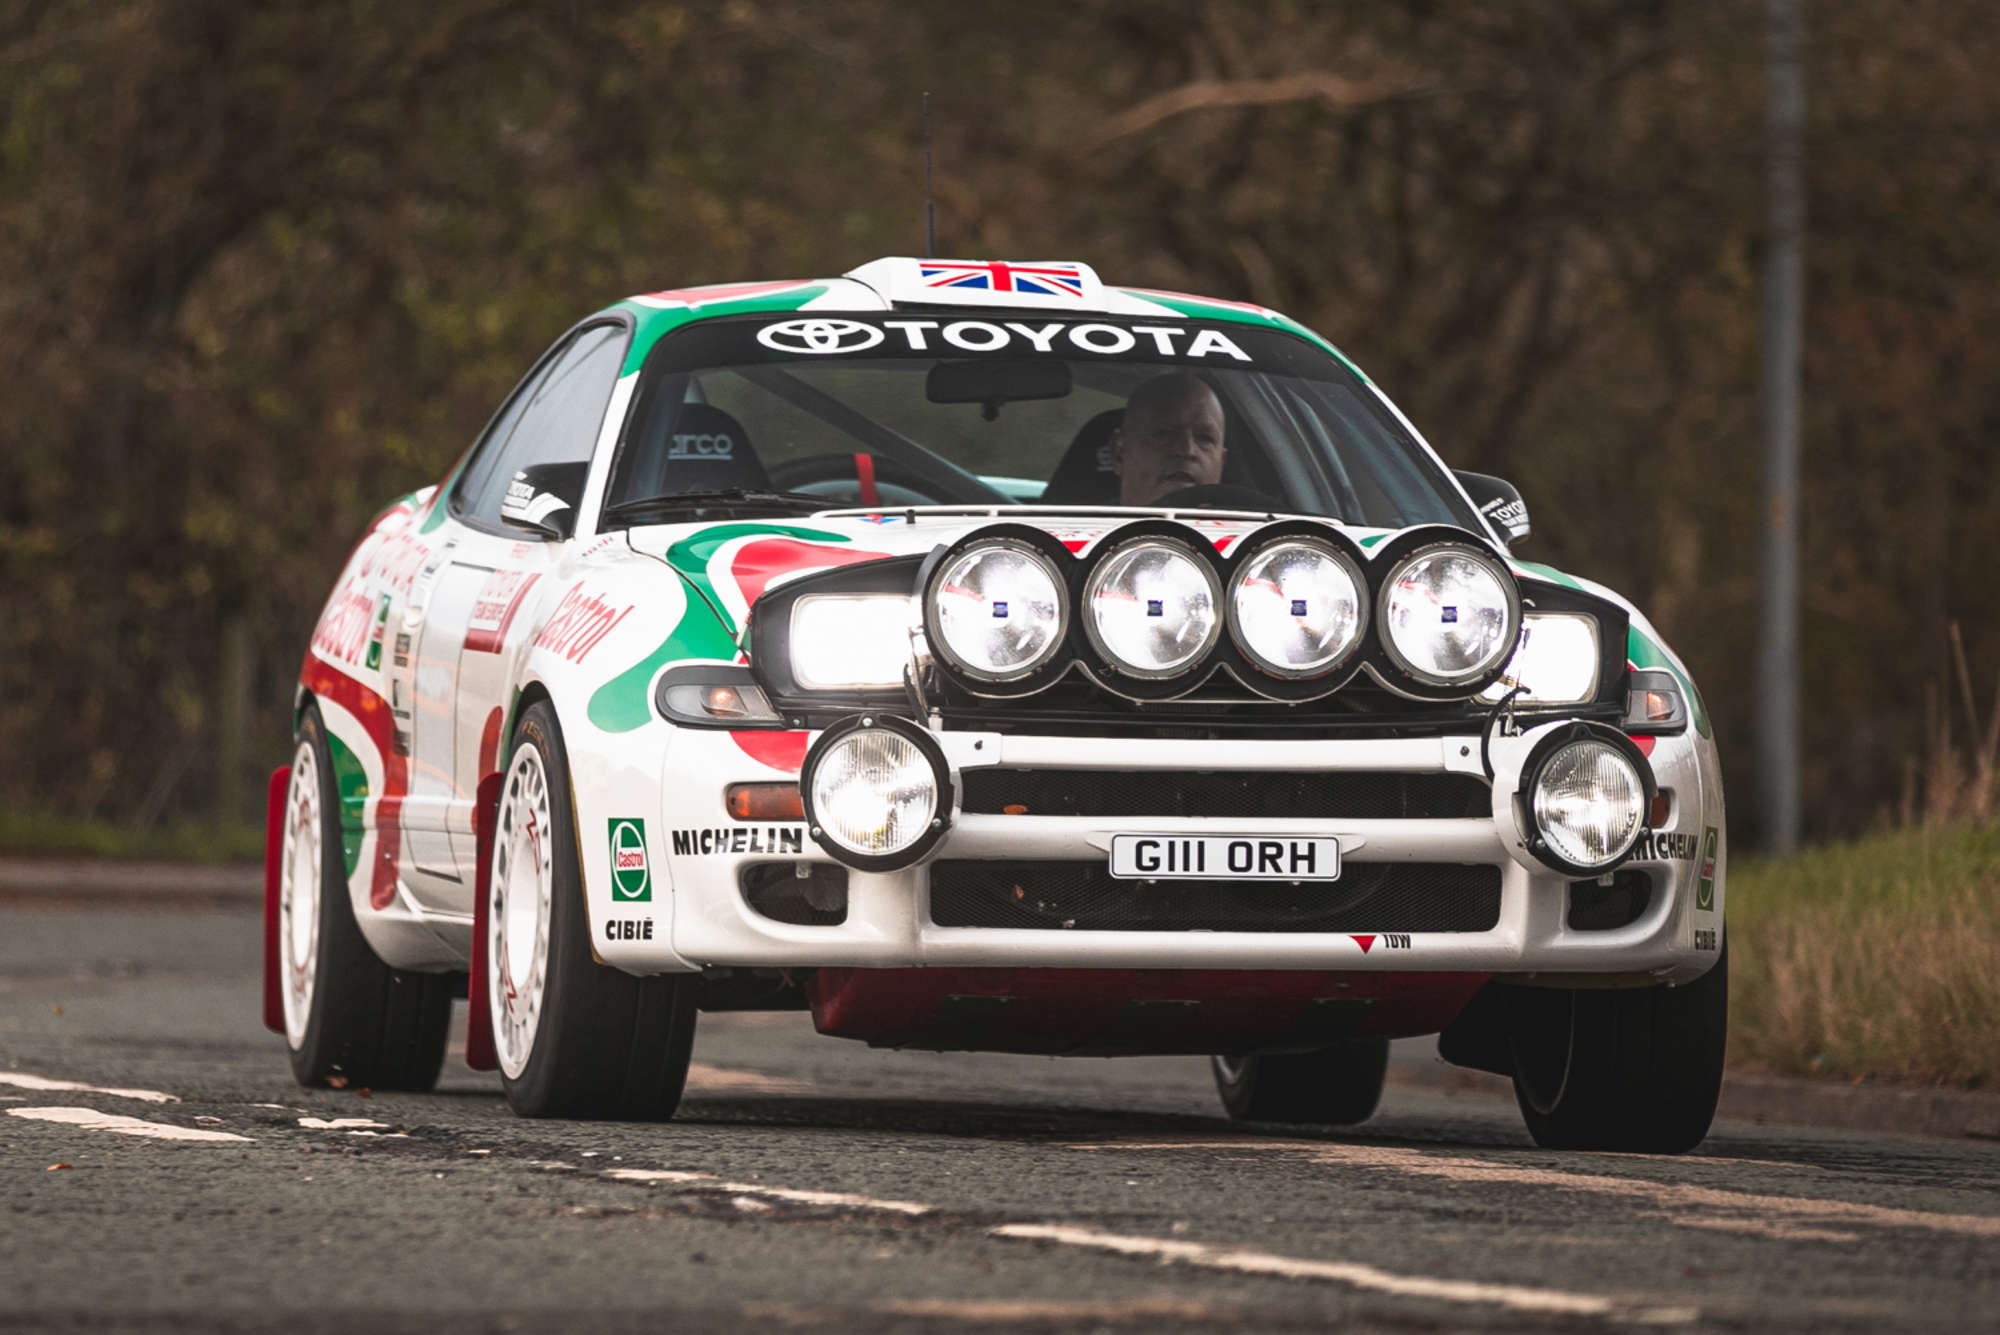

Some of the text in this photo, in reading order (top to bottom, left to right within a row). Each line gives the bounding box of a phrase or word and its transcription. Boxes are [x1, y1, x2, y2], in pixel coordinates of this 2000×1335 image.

[884, 320, 1253, 361] TOYOTA
[668, 434, 734, 455] arco
[534, 580, 635, 665] Castrol
[672, 827, 803, 856] MICHELIN
[618, 851, 644, 868] Castrol
[1227, 841, 1316, 873] ORH
[1382, 934, 1411, 949] TOW
